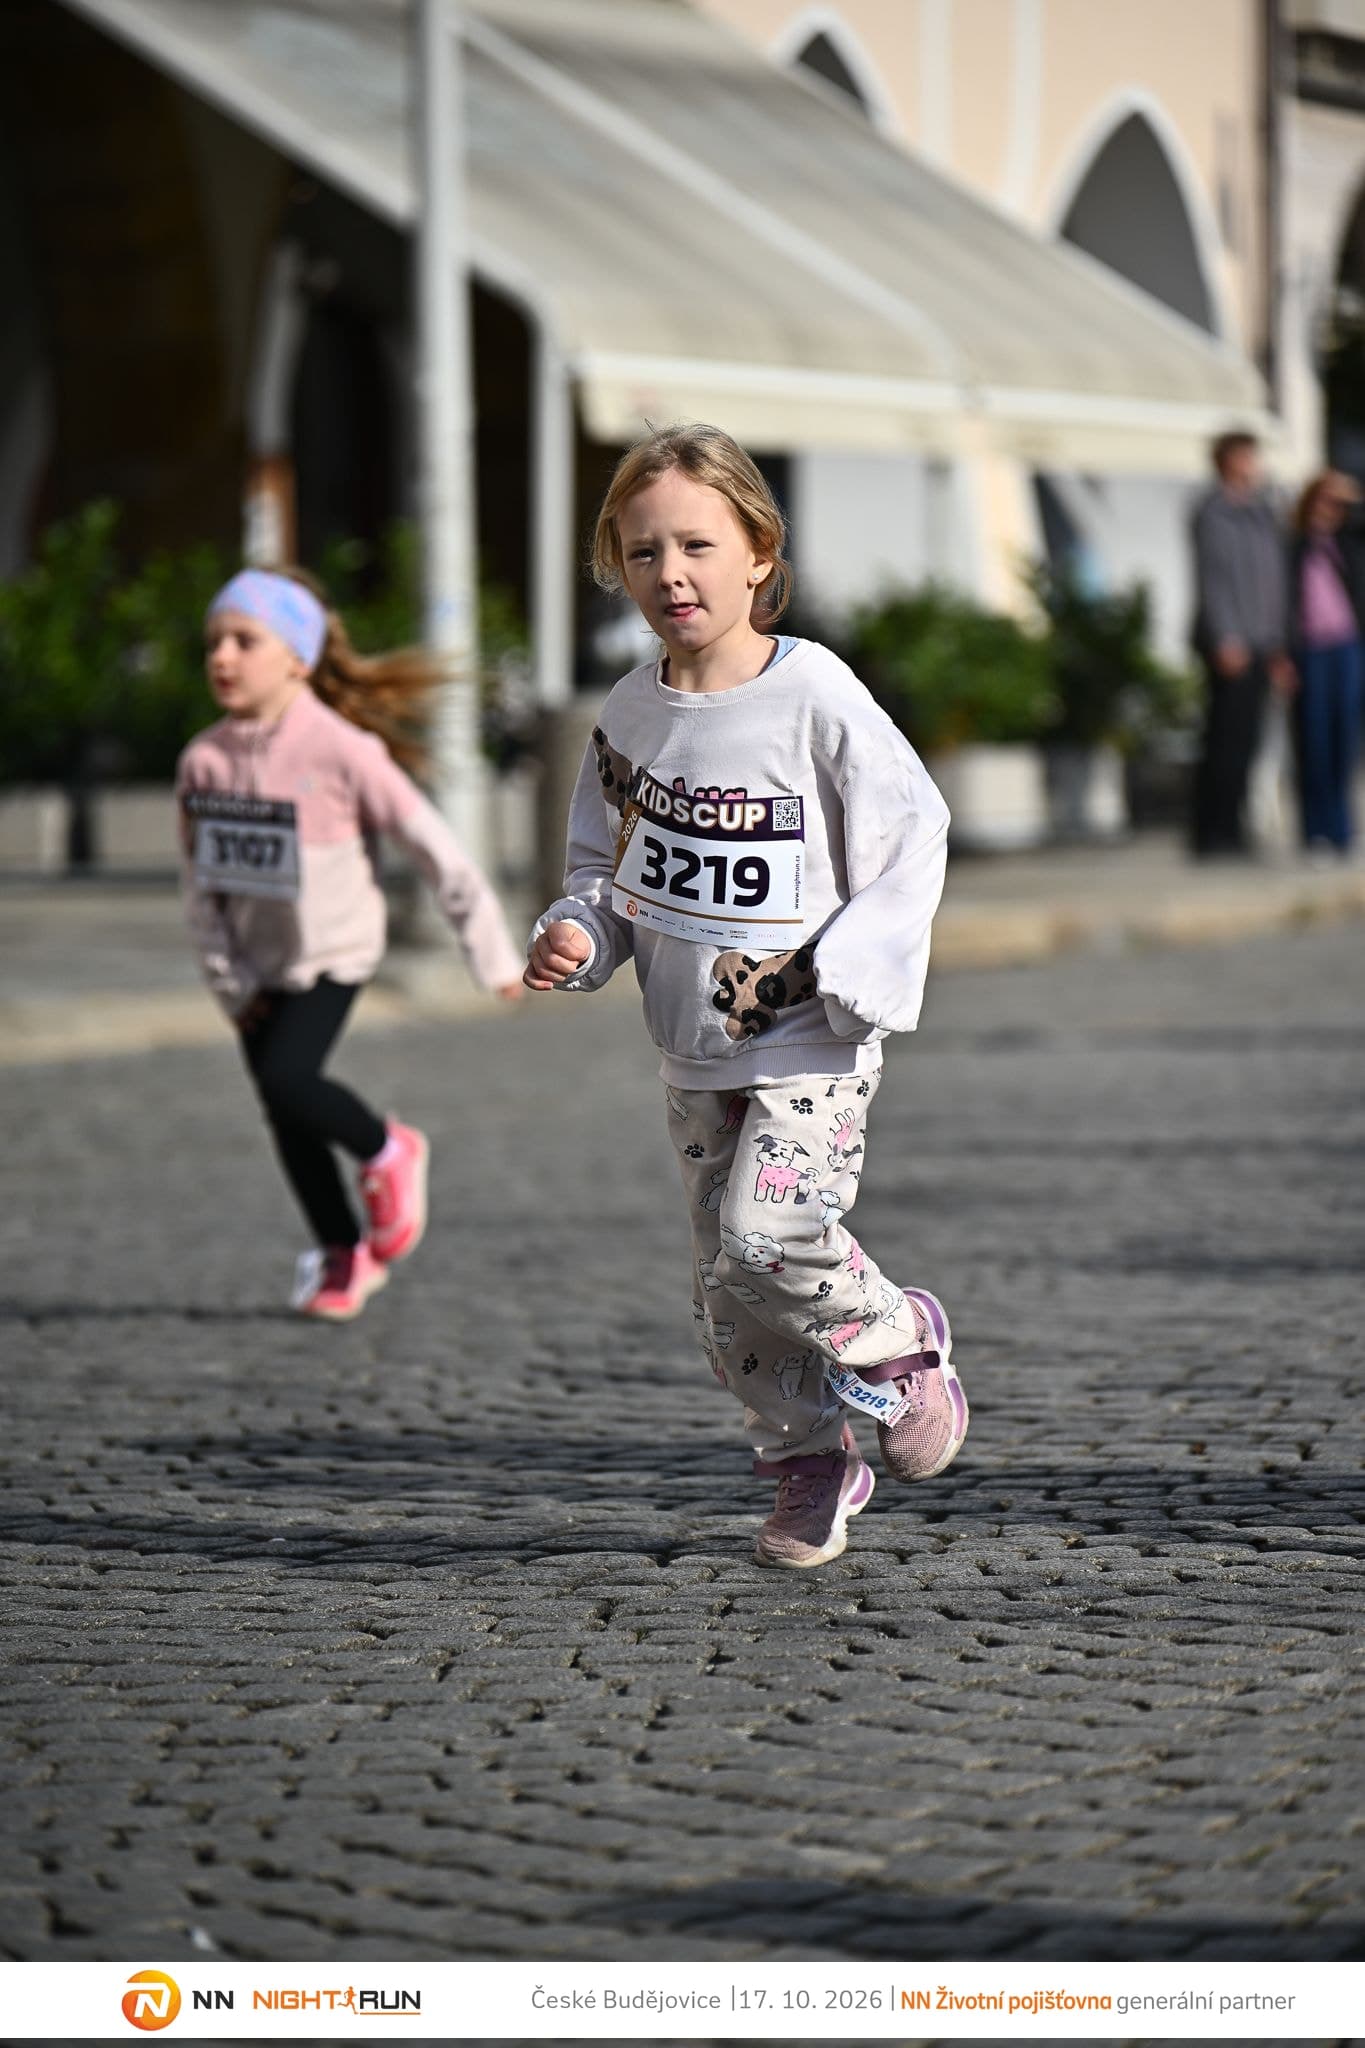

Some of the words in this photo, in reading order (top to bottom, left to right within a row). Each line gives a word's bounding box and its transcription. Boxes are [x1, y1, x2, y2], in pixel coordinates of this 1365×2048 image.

[636, 777, 766, 831] KIDSCUP
[621, 810, 639, 842] 2026
[640, 835, 770, 907] 3219
[848, 1386, 888, 1410] 3219
